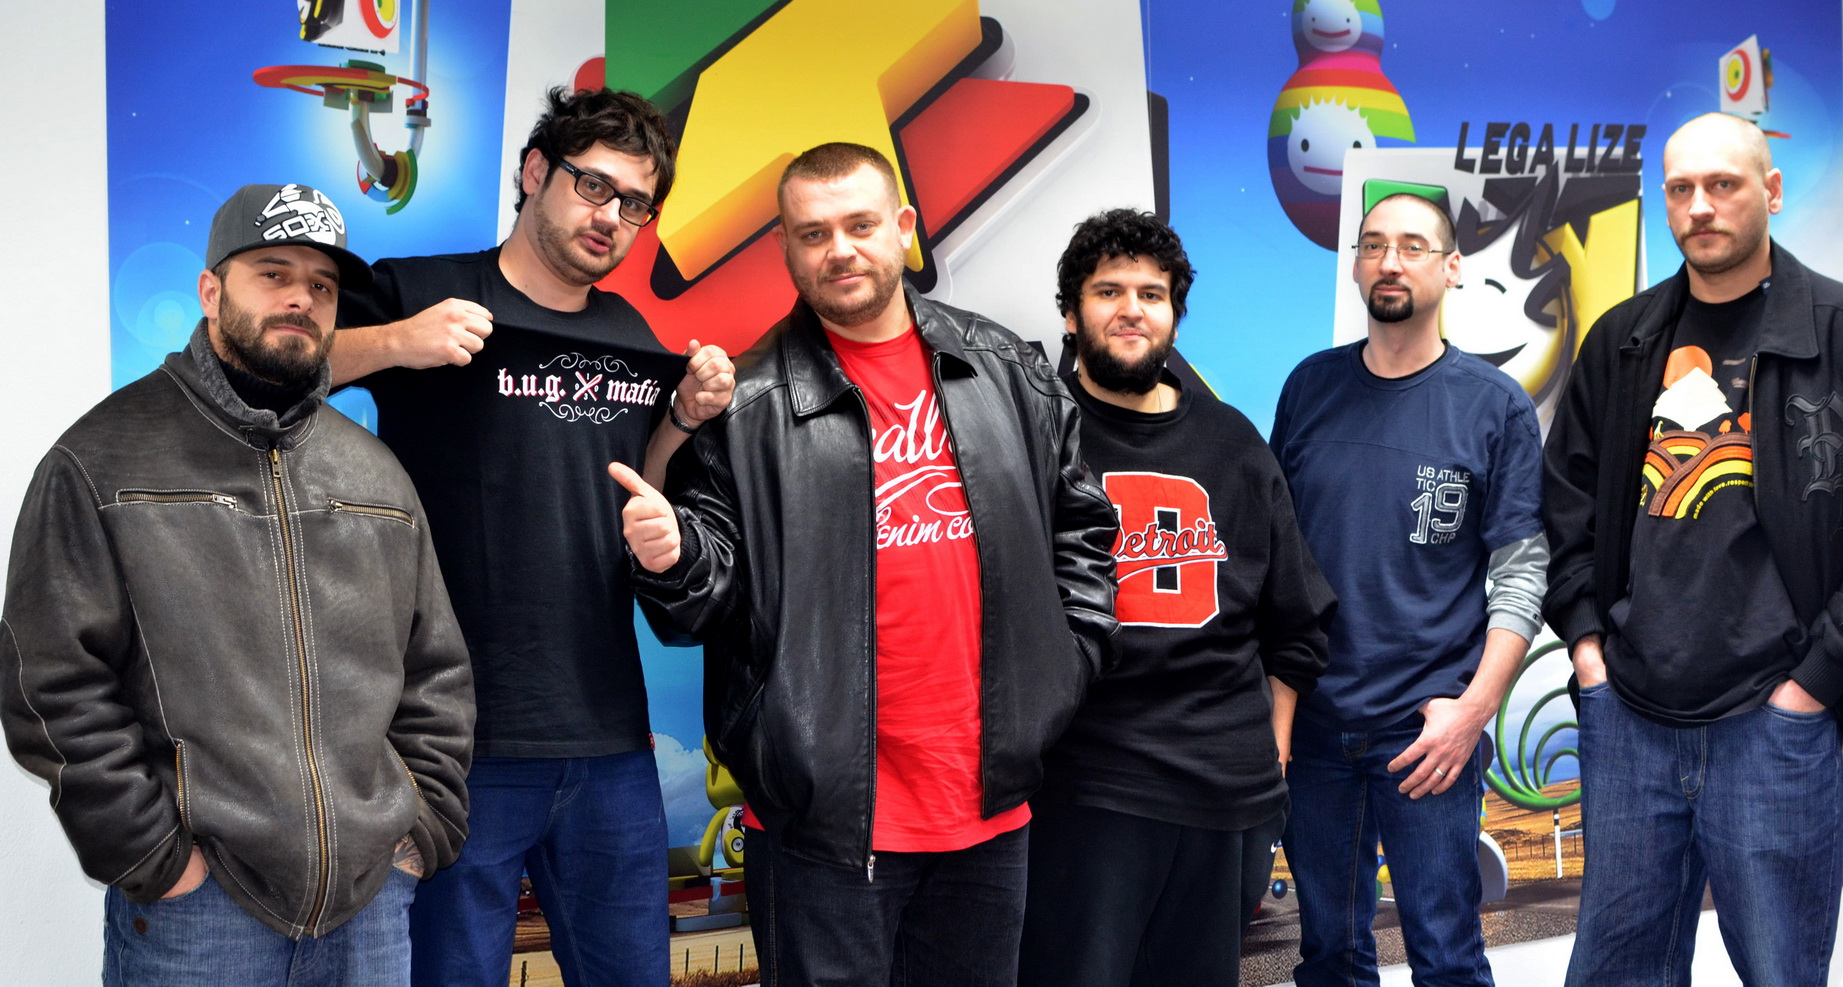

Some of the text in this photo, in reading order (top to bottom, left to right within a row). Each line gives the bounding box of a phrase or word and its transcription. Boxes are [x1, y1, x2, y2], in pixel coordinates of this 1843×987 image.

[1454, 121, 1647, 176] LEGALIZE
[498, 368, 660, 406] b.u.g. mafia
[1416, 477, 1436, 492] TIC
[1417, 465, 1470, 482] US ATHLE
[1410, 483, 1468, 544] 19
[1430, 532, 1456, 544] CHP
